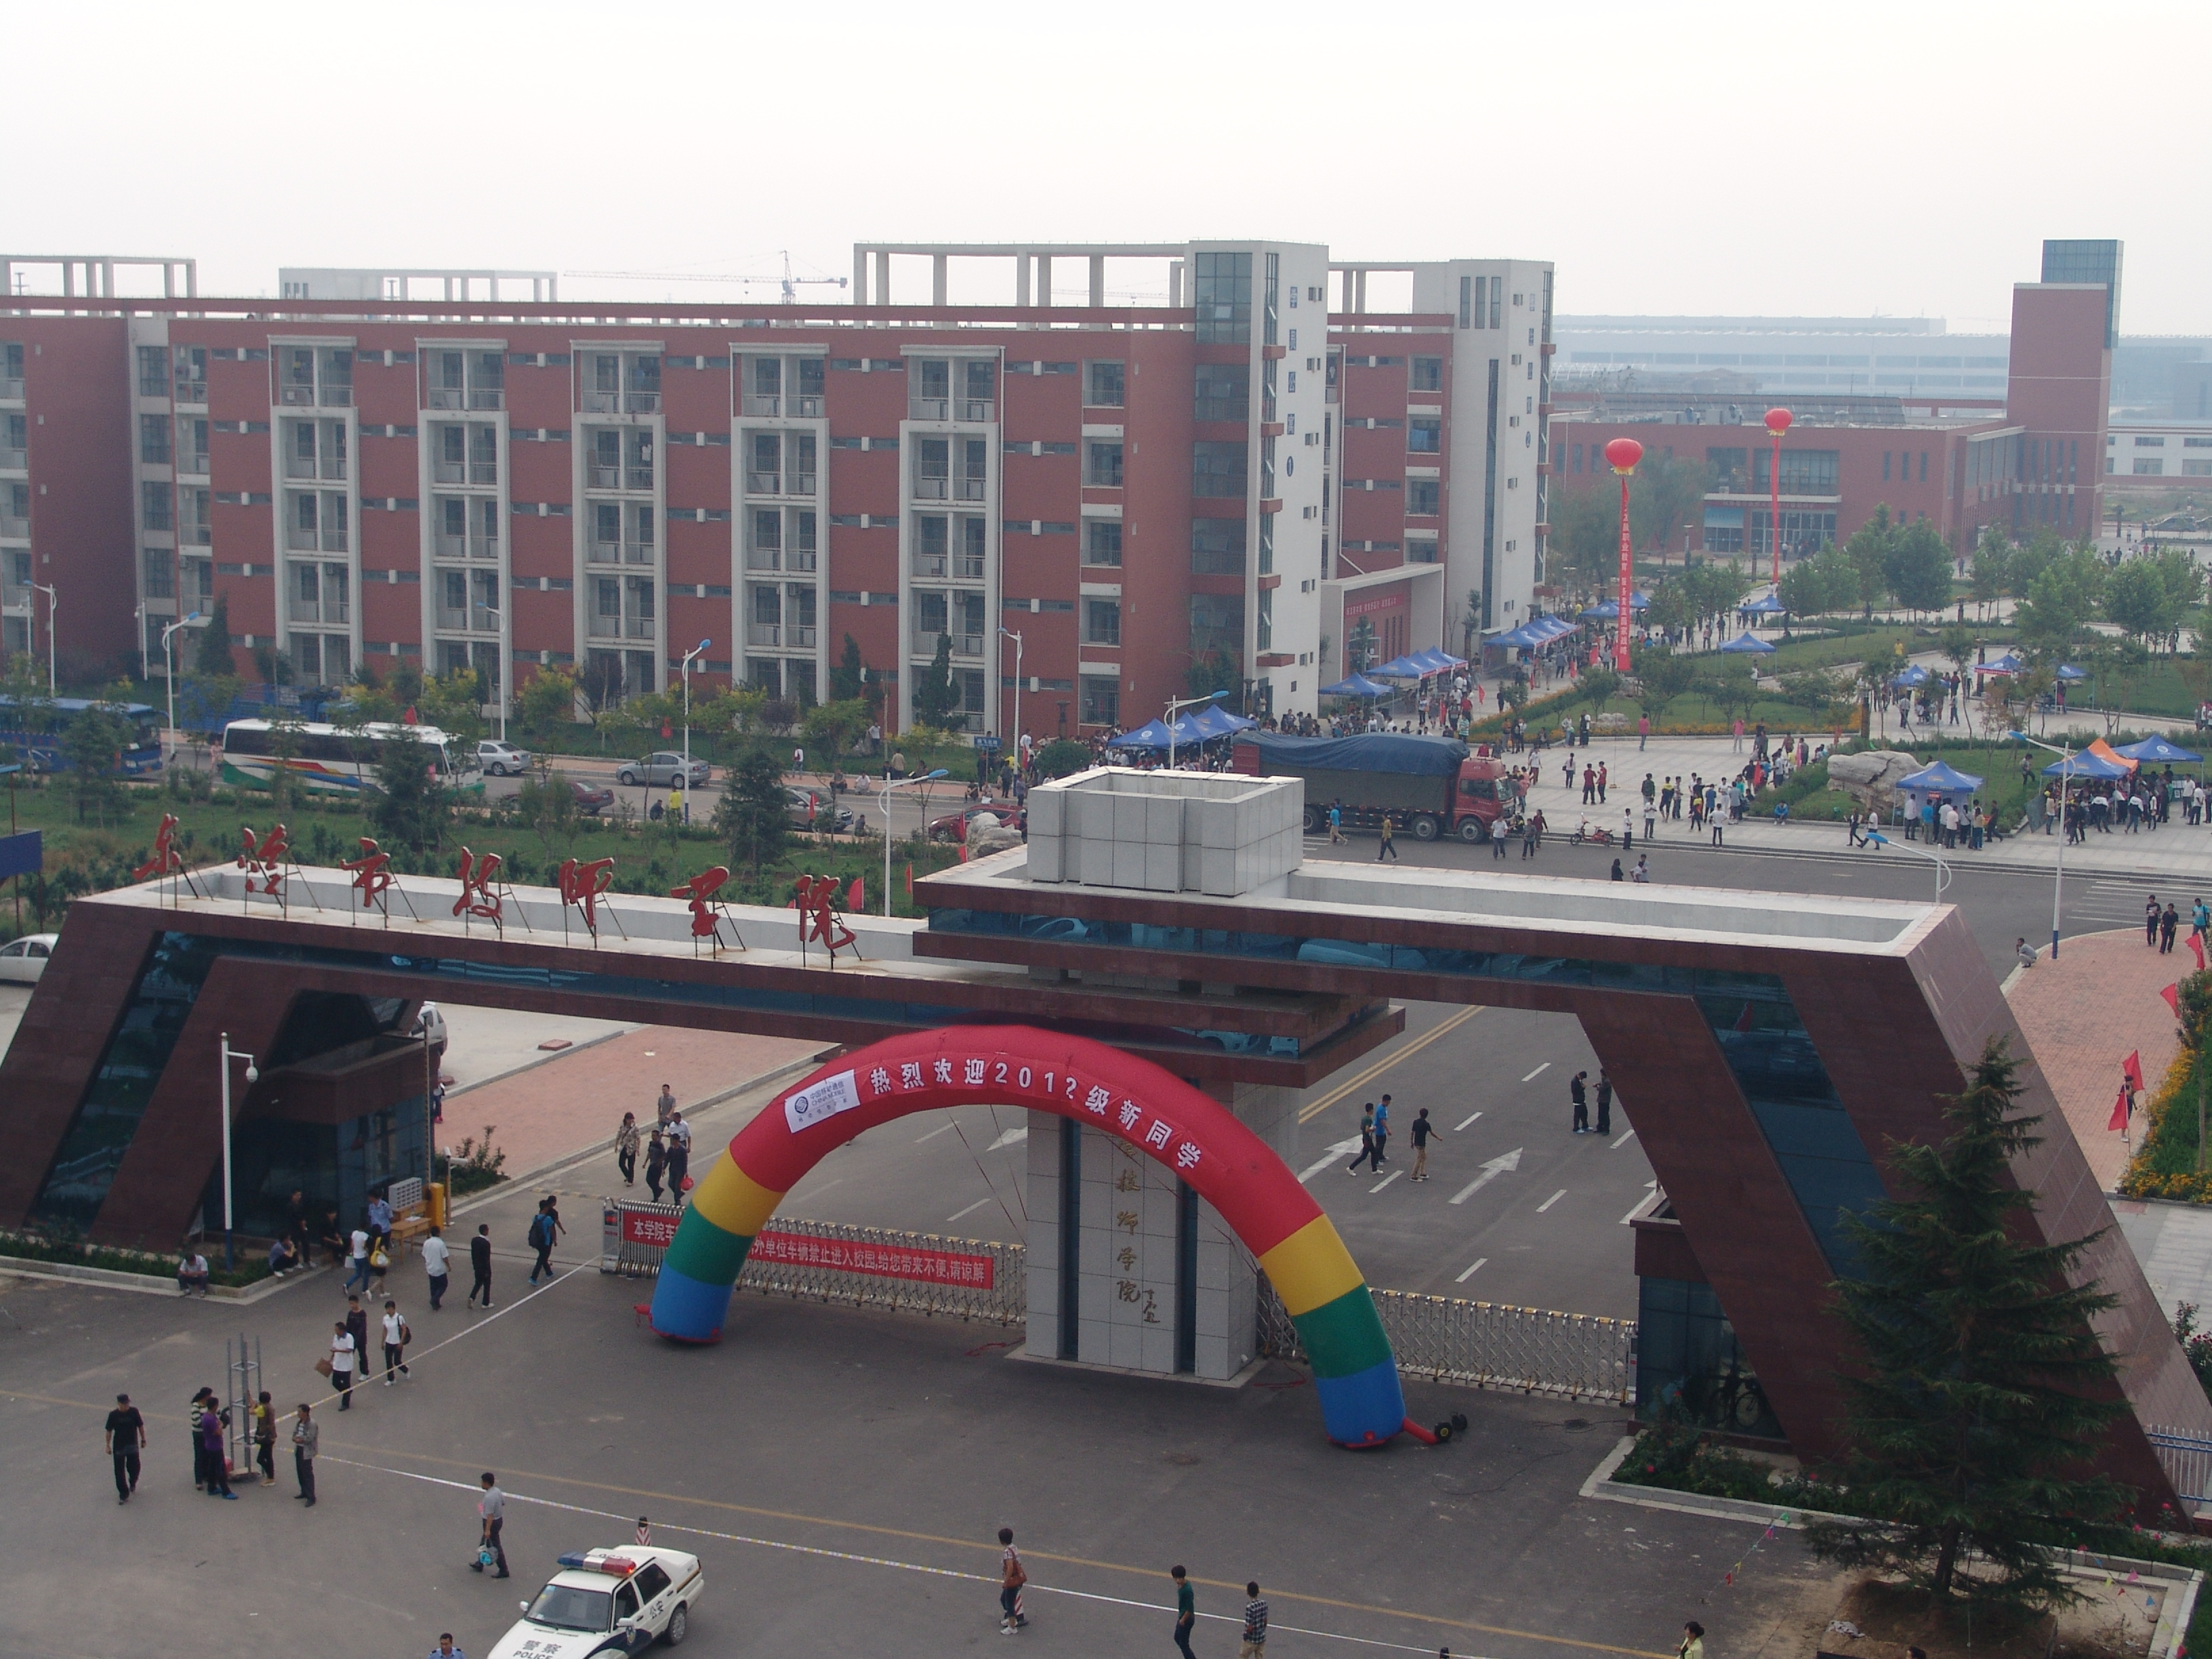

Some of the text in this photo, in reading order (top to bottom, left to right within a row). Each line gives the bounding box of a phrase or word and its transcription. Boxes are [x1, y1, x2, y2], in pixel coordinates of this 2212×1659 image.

[810, 1081, 844, 1099] 中国移动通信
[870, 1058, 1202, 1170] 热烈欢迎2012级新同学
[634, 1218, 678, 1242] 本学院车
[649, 1600, 664, 1620] 公安
[513, 1650, 553, 1659] POLICE
[523, 1640, 562, 1654] 警察
